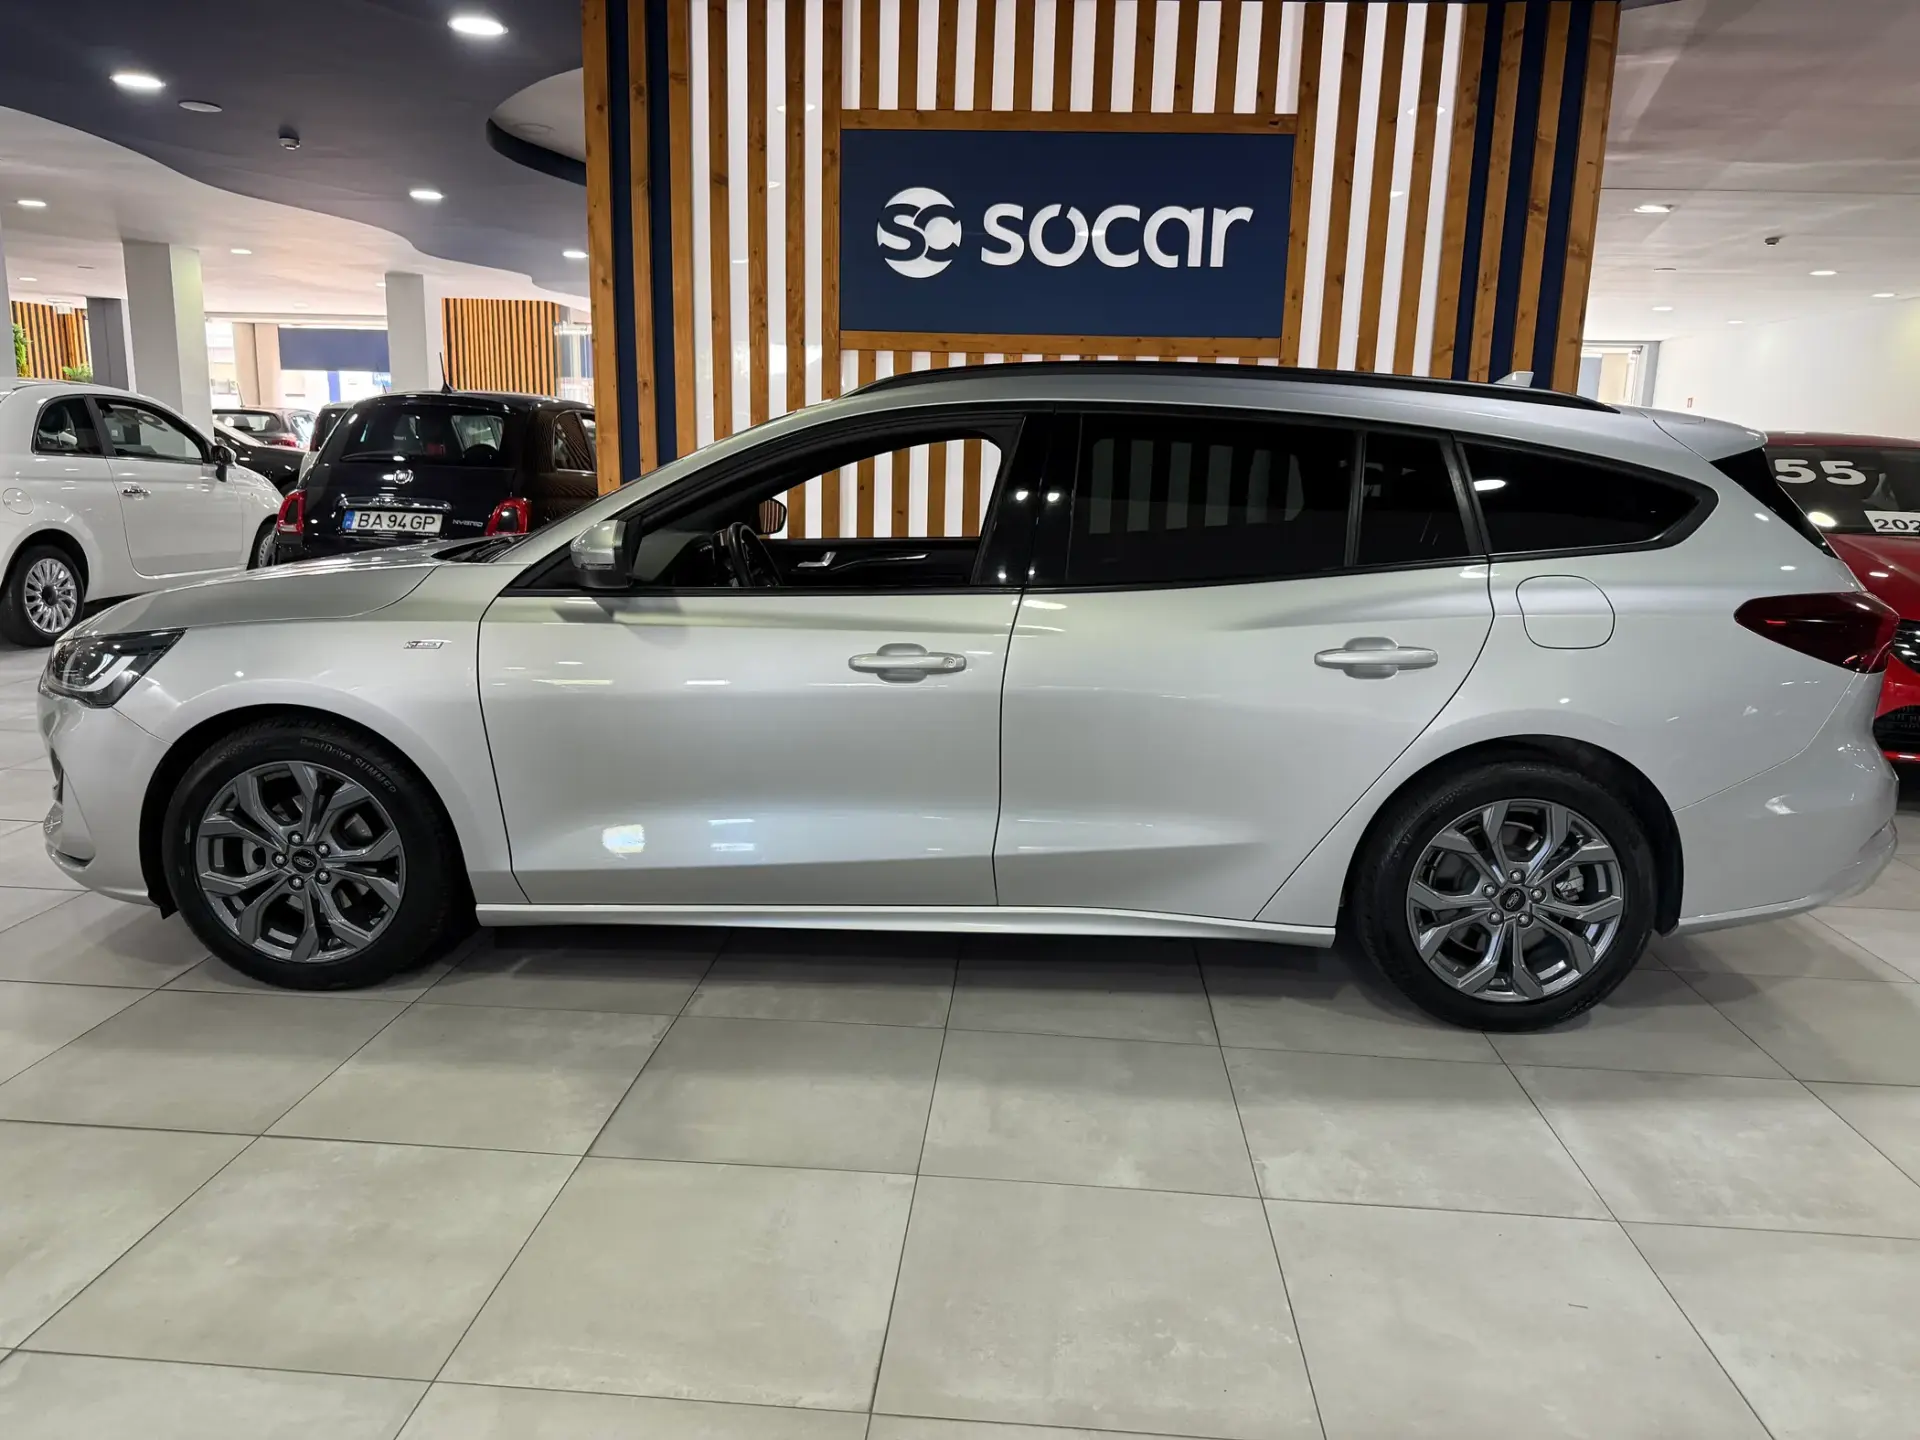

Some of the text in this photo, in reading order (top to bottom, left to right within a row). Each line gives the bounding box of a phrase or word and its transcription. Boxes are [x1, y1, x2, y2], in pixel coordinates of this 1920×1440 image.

[1774, 459, 1867, 486] 55
[357, 513, 383, 528] BA
[387, 515, 407, 529] 94
[410, 517, 435, 531] GP
